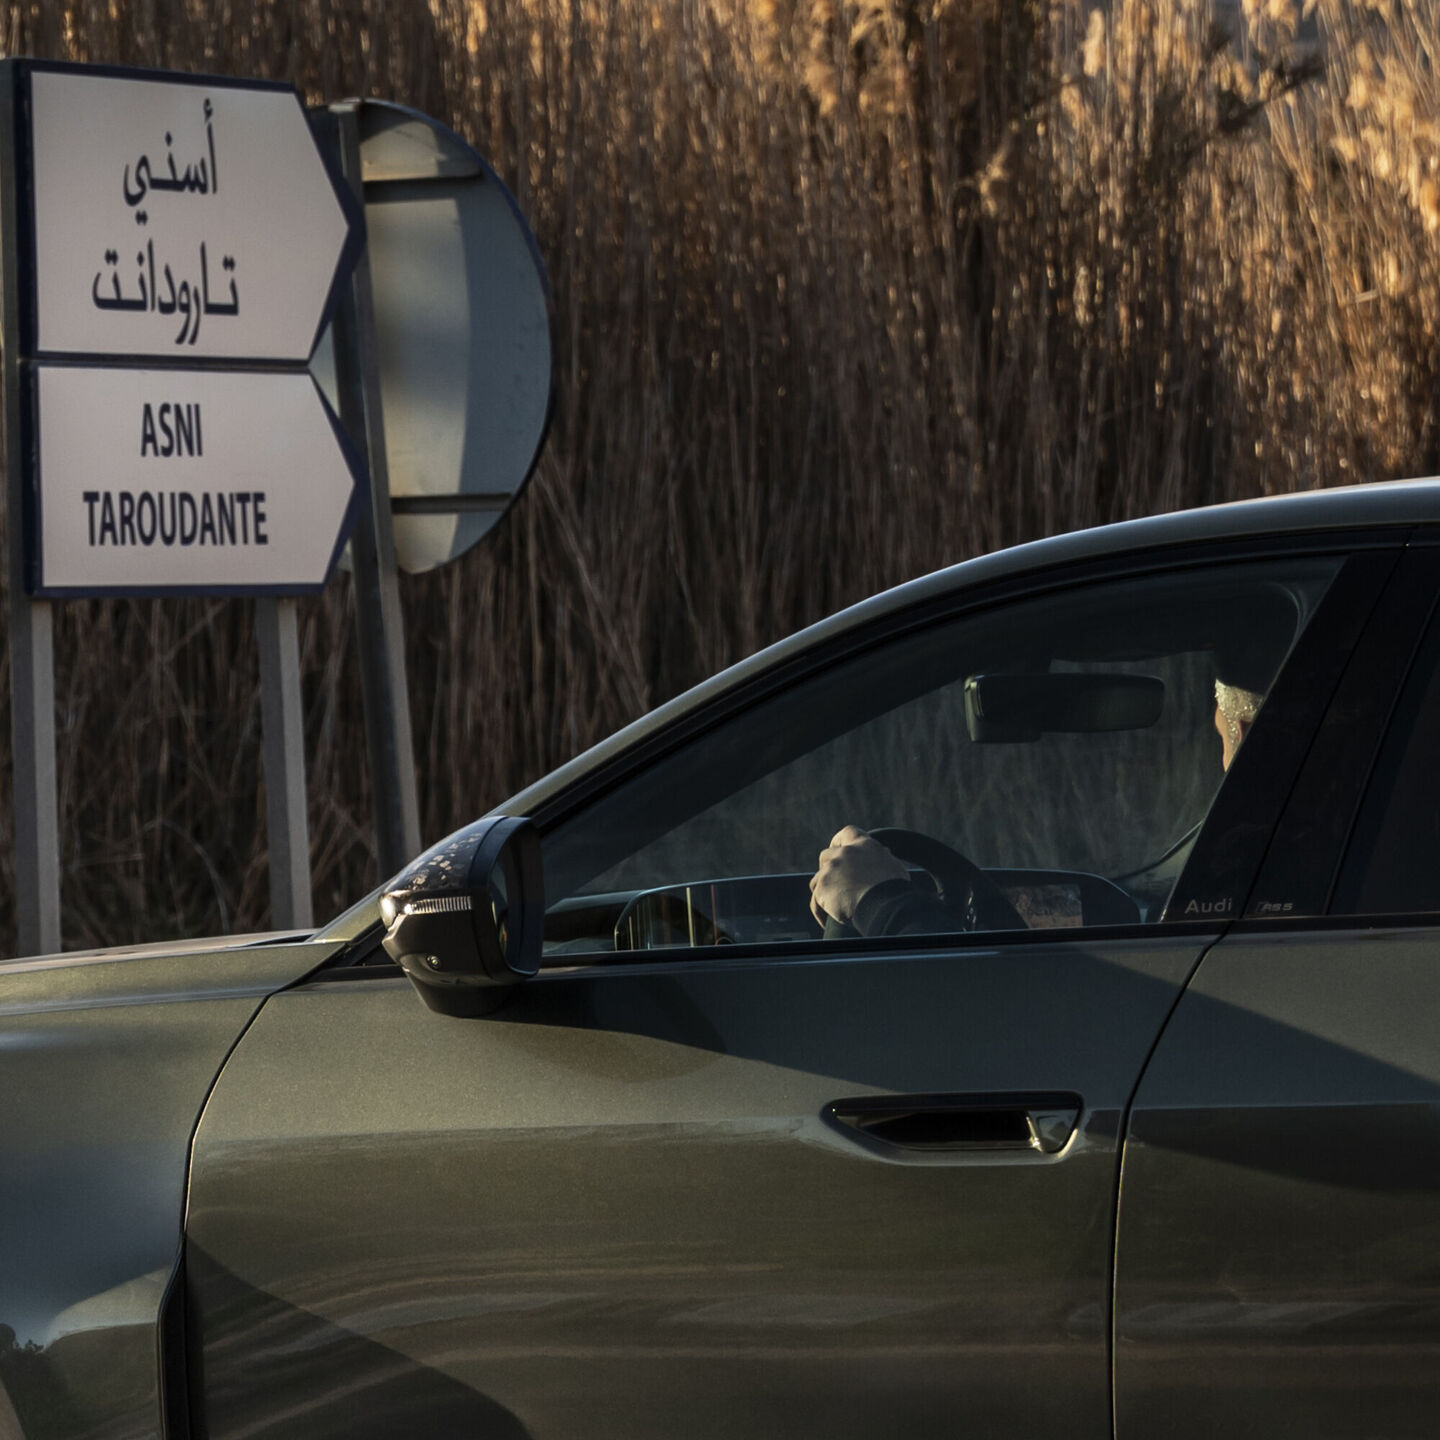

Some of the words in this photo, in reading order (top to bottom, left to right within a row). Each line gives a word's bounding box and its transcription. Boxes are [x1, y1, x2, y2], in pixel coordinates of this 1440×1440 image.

[123, 97, 219, 225] أسني
[92, 238, 240, 346] تارودانت
[140, 402, 203, 458] ASNI
[82, 490, 269, 547] TAROUDANTE
[1184, 897, 1232, 914] Audi
